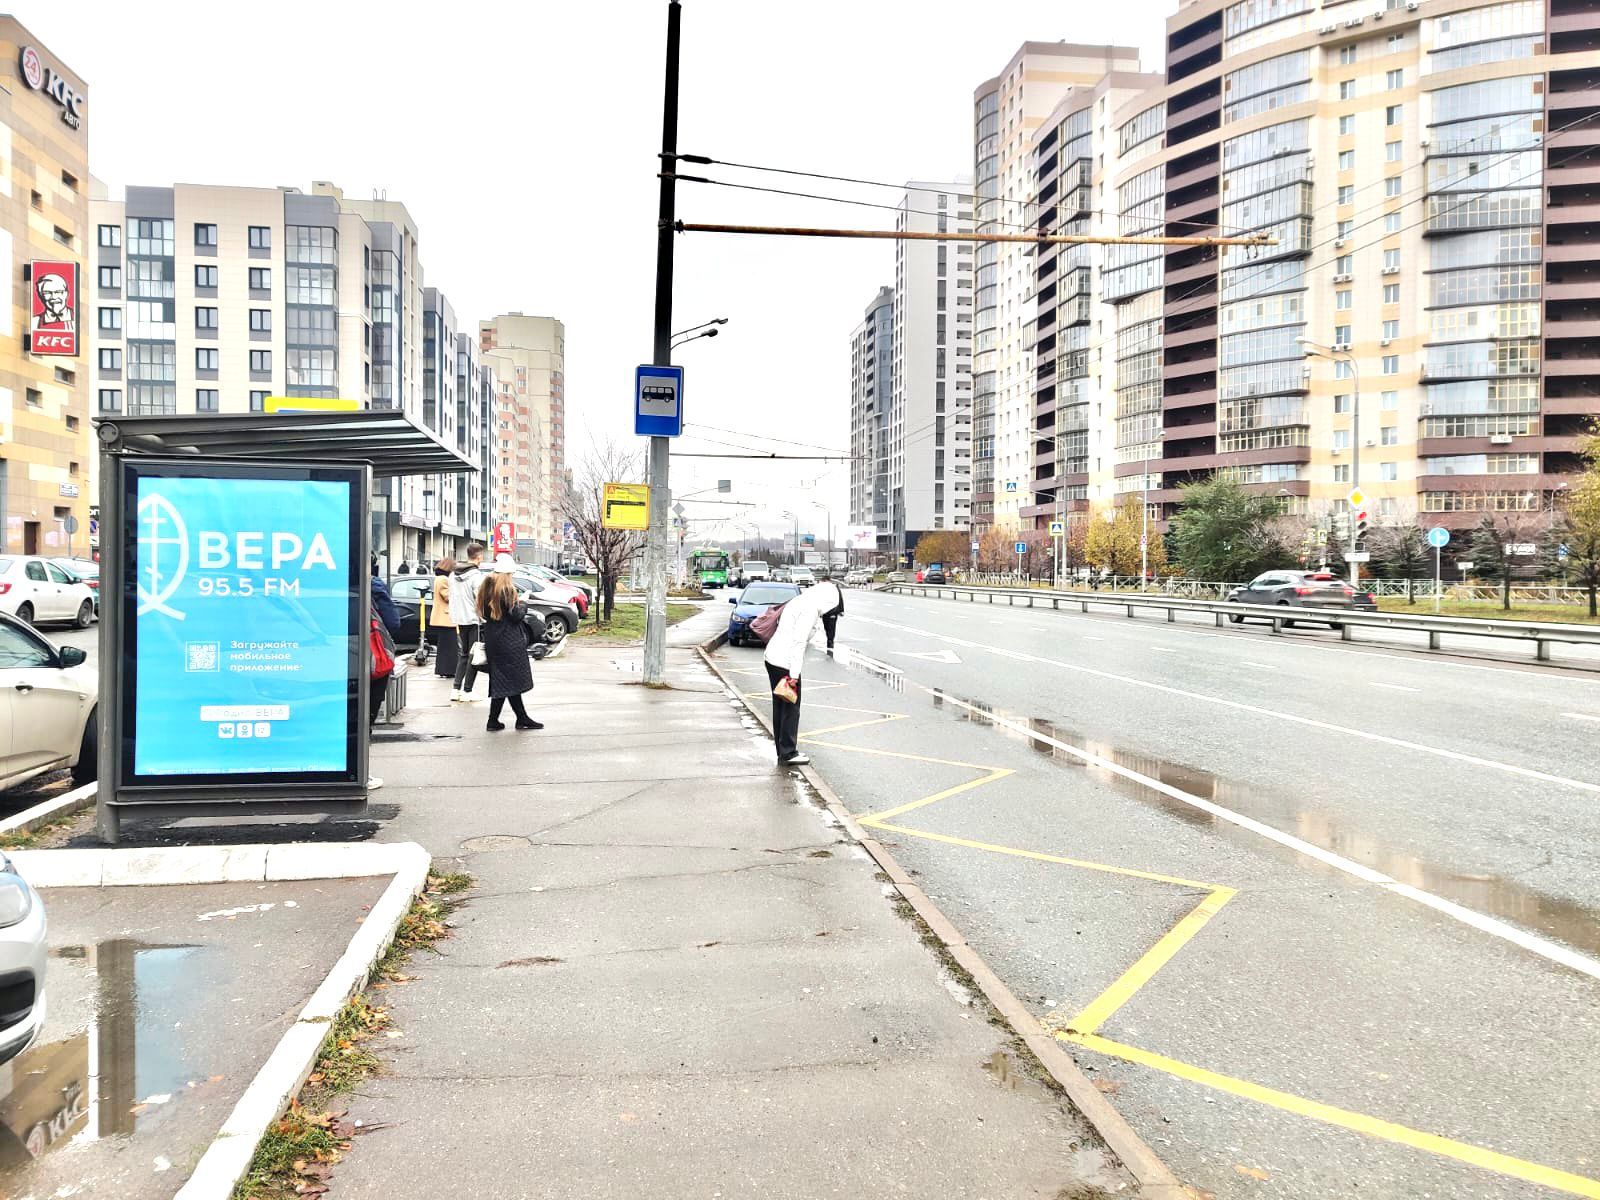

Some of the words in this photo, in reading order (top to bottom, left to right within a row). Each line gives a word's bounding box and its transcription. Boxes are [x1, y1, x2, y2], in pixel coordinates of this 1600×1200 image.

[45, 68, 83, 117] KFC
[36, 335, 73, 348] KFC
[198, 531, 337, 570] ВЕРА
[198, 577, 255, 597] 95.5
[263, 577, 301, 597] FM
[230, 640, 300, 650] Загружайте
[229, 651, 293, 660] мобильное
